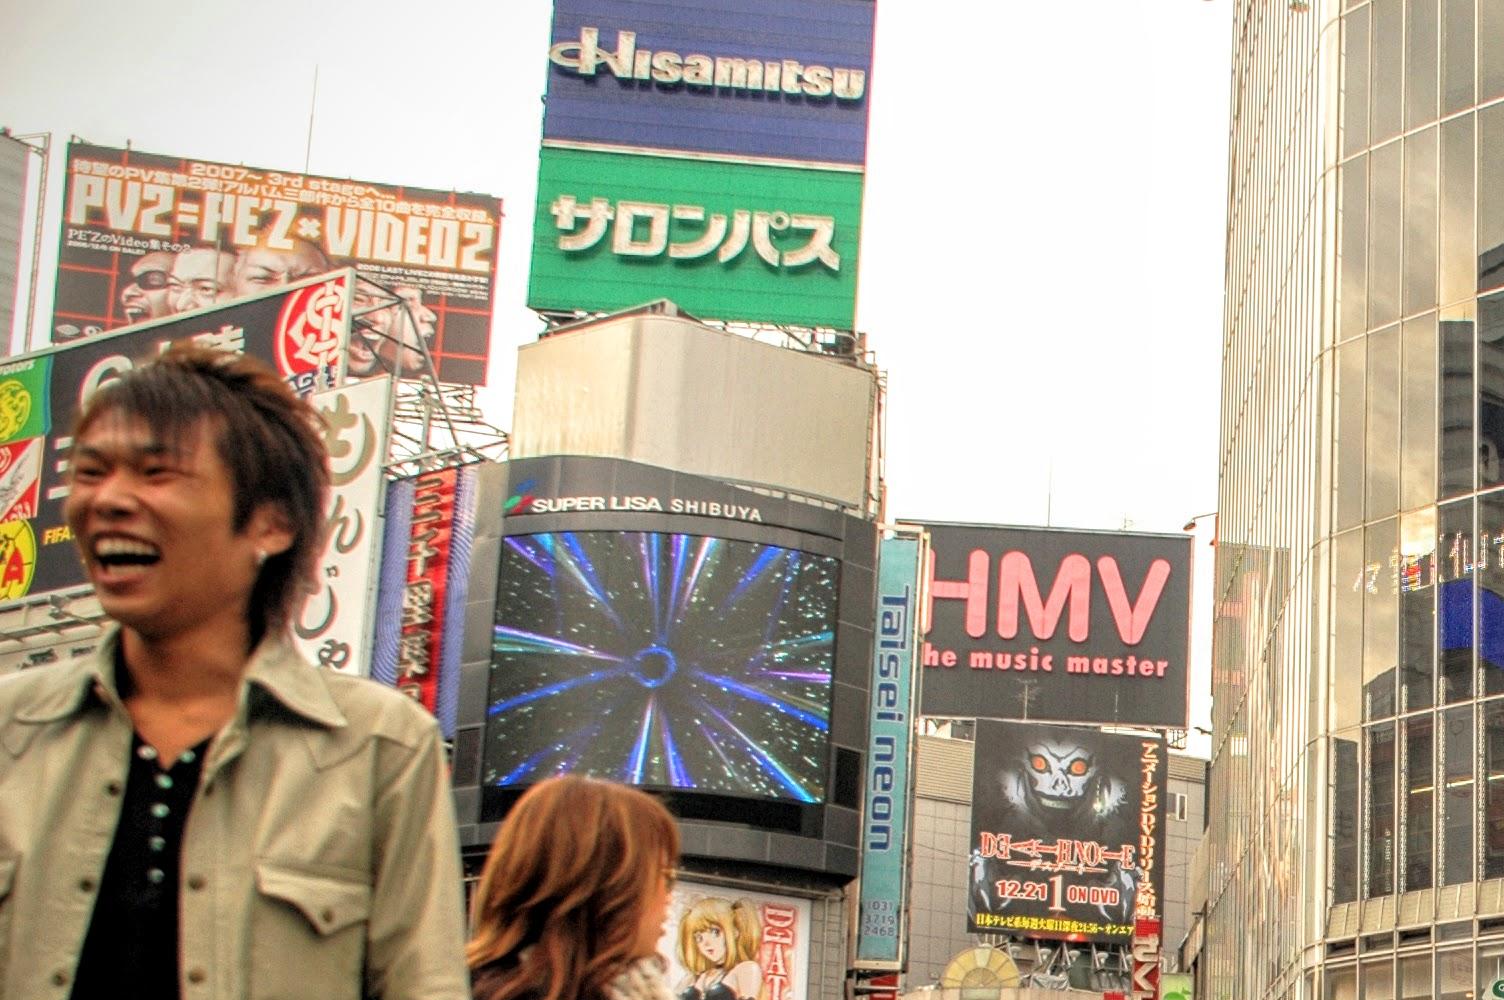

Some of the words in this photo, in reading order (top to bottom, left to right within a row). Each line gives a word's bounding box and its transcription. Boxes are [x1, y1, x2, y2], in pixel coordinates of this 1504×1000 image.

[549, 27, 866, 100] Hisamitsu
[551, 195, 840, 271] サロンパス
[531, 496, 605, 513] SUPER
[610, 495, 662, 511] LISA
[671, 498, 763, 522] SHIBUYA
[924, 549, 1171, 645] HMV
[877, 585, 910, 723] Taisei
[970, 646, 1053, 672] music
[1066, 654, 1169, 678] master
[869, 736, 903, 852] neon
[996, 879, 1047, 901] 12.21
[1067, 885, 1087, 903] ON
[1090, 887, 1119, 905] DVD
